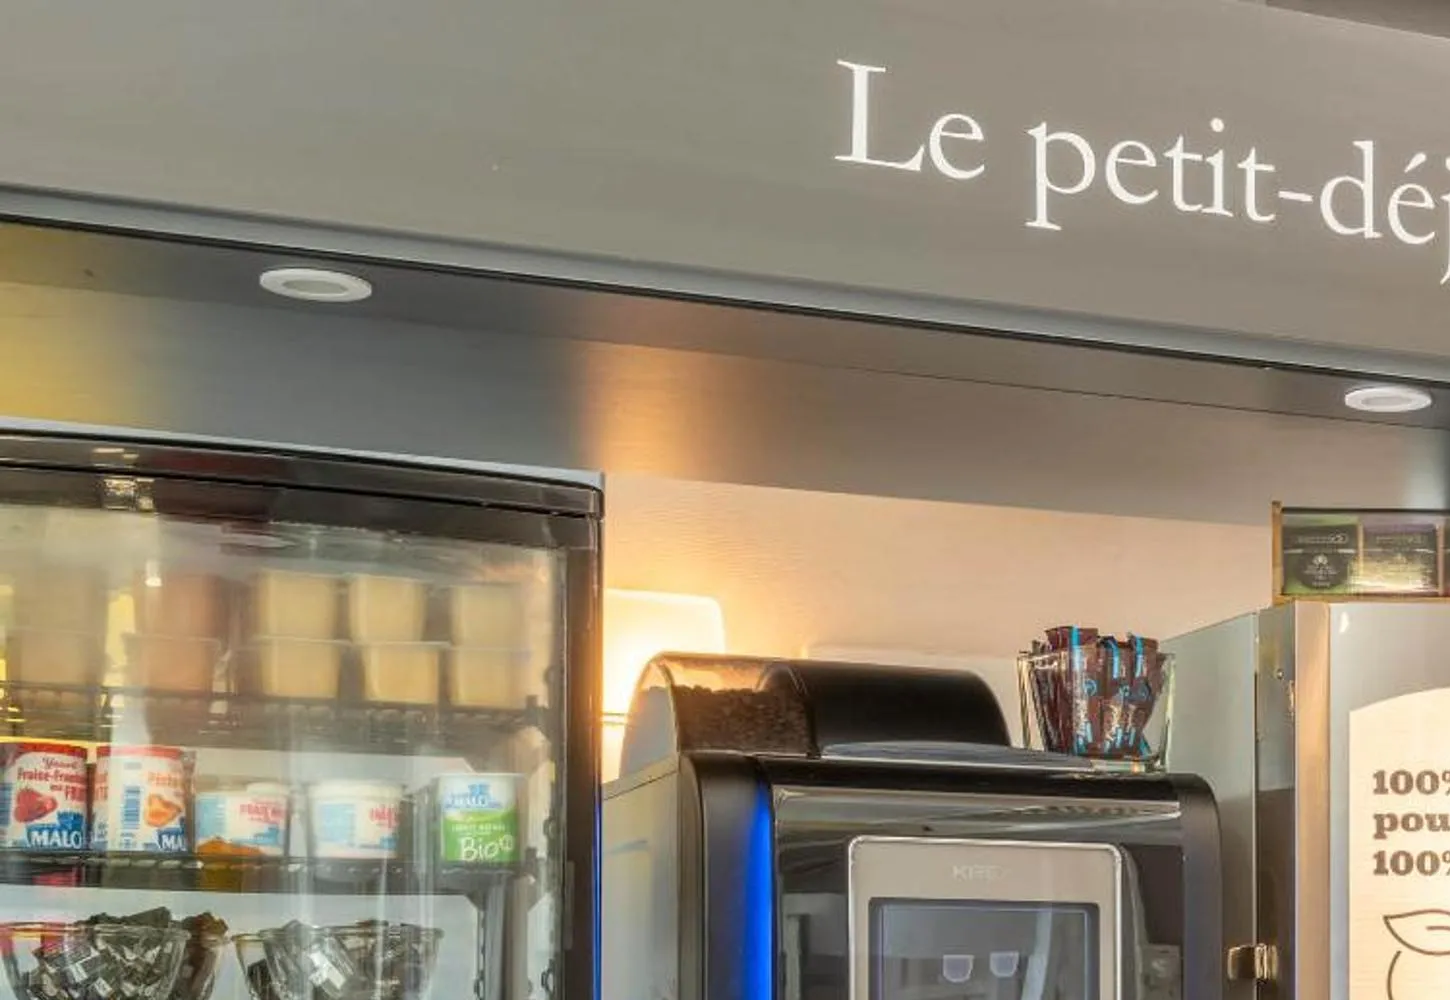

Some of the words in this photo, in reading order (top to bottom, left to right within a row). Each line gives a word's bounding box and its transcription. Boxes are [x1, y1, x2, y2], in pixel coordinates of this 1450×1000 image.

[834, 59, 985, 180] Le
[30, 829, 83, 849] MALO
[460, 836, 499, 862] Bio
